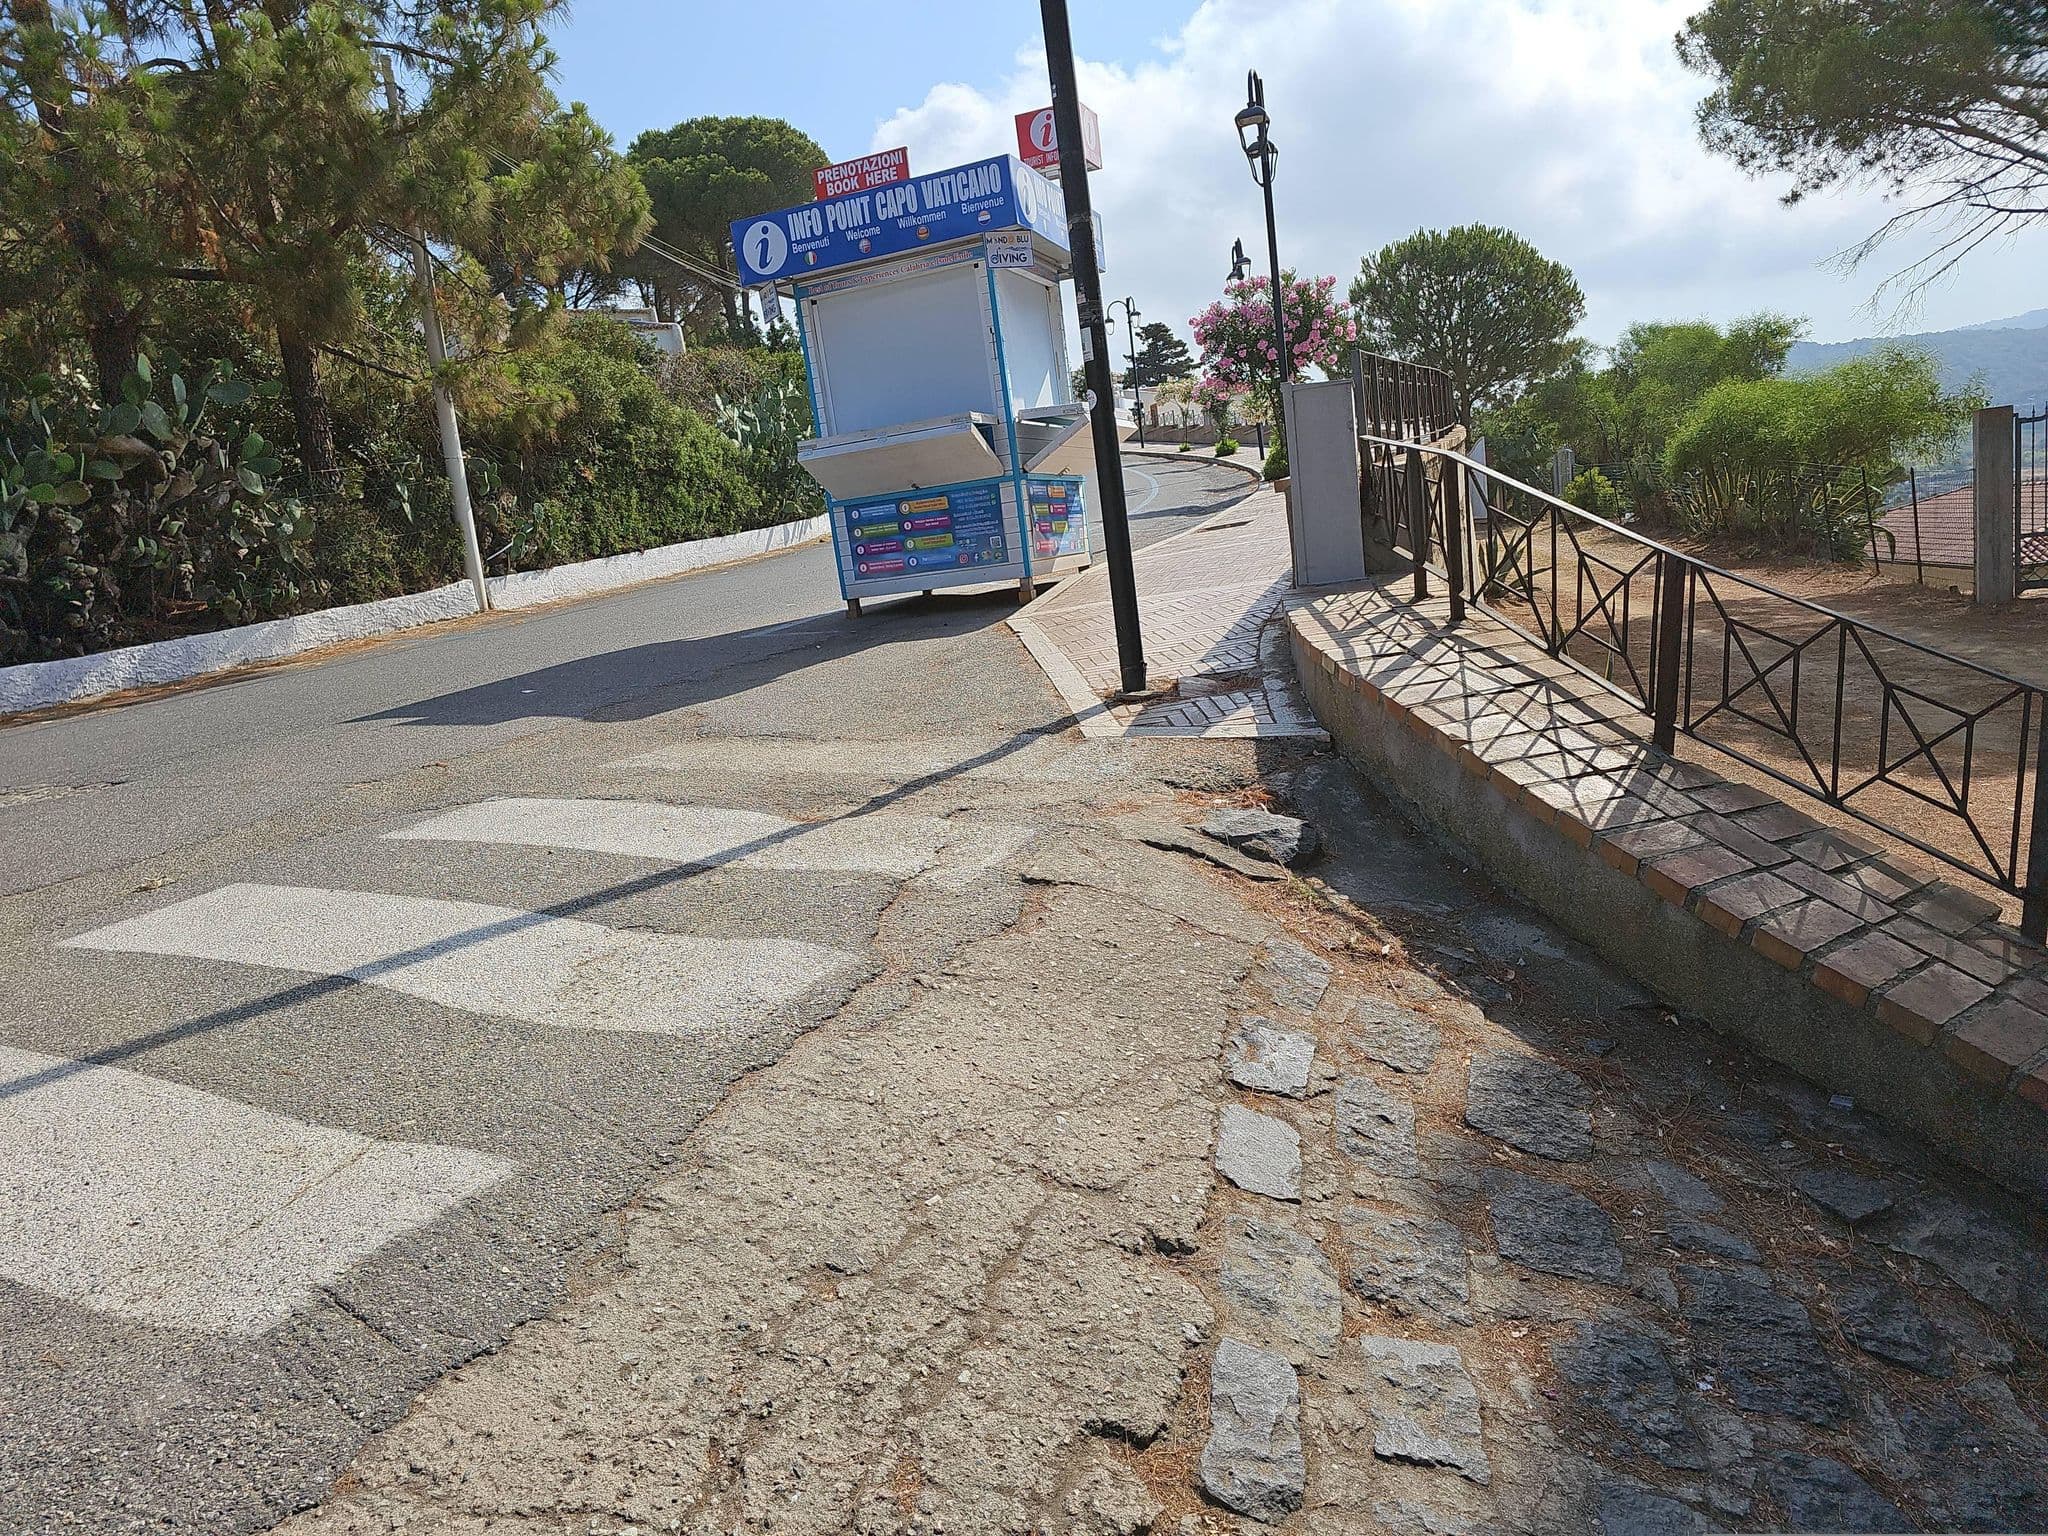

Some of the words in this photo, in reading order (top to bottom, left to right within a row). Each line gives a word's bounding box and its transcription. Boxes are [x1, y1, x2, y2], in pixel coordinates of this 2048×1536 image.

[817, 150, 904, 184] PRENOTAZIONI
[826, 179, 859, 197] BOOK
[866, 166, 898, 187] HERE
[787, 208, 823, 242] INFO
[825, 196, 871, 233] POINT
[875, 184, 919, 221] CAPO
[920, 163, 1002, 209] VATICANO
[961, 196, 1005, 214] Bienvenue
[897, 210, 947, 230] Willkommen
[845, 225, 881, 242] Welcome
[792, 236, 830, 254] Benvenuti
[861, 268, 899, 284] Experiences
[900, 260, 929, 273] Calabria
